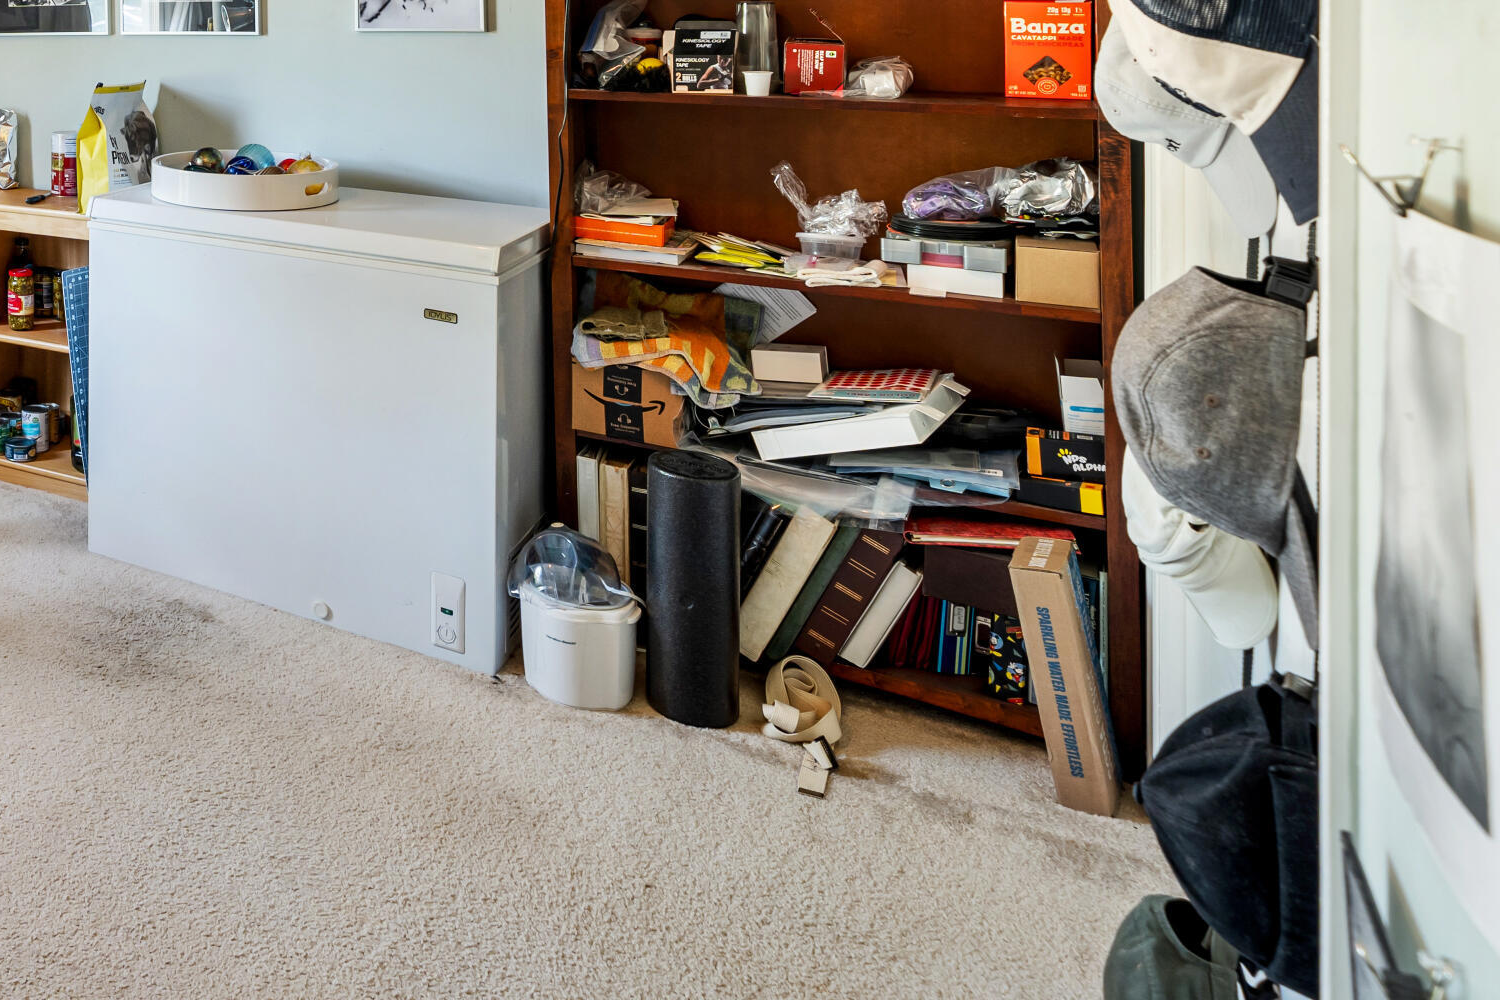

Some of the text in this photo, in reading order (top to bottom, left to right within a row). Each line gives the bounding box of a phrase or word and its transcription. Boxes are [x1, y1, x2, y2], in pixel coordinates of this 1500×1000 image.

[1010, 17, 1085, 34] Banza
[675, 72, 682, 81] 2
[428, 311, 452, 321] IDYLIS
[1035, 606, 1085, 779] SPARKLING WATER MADE EFFORTLESS
